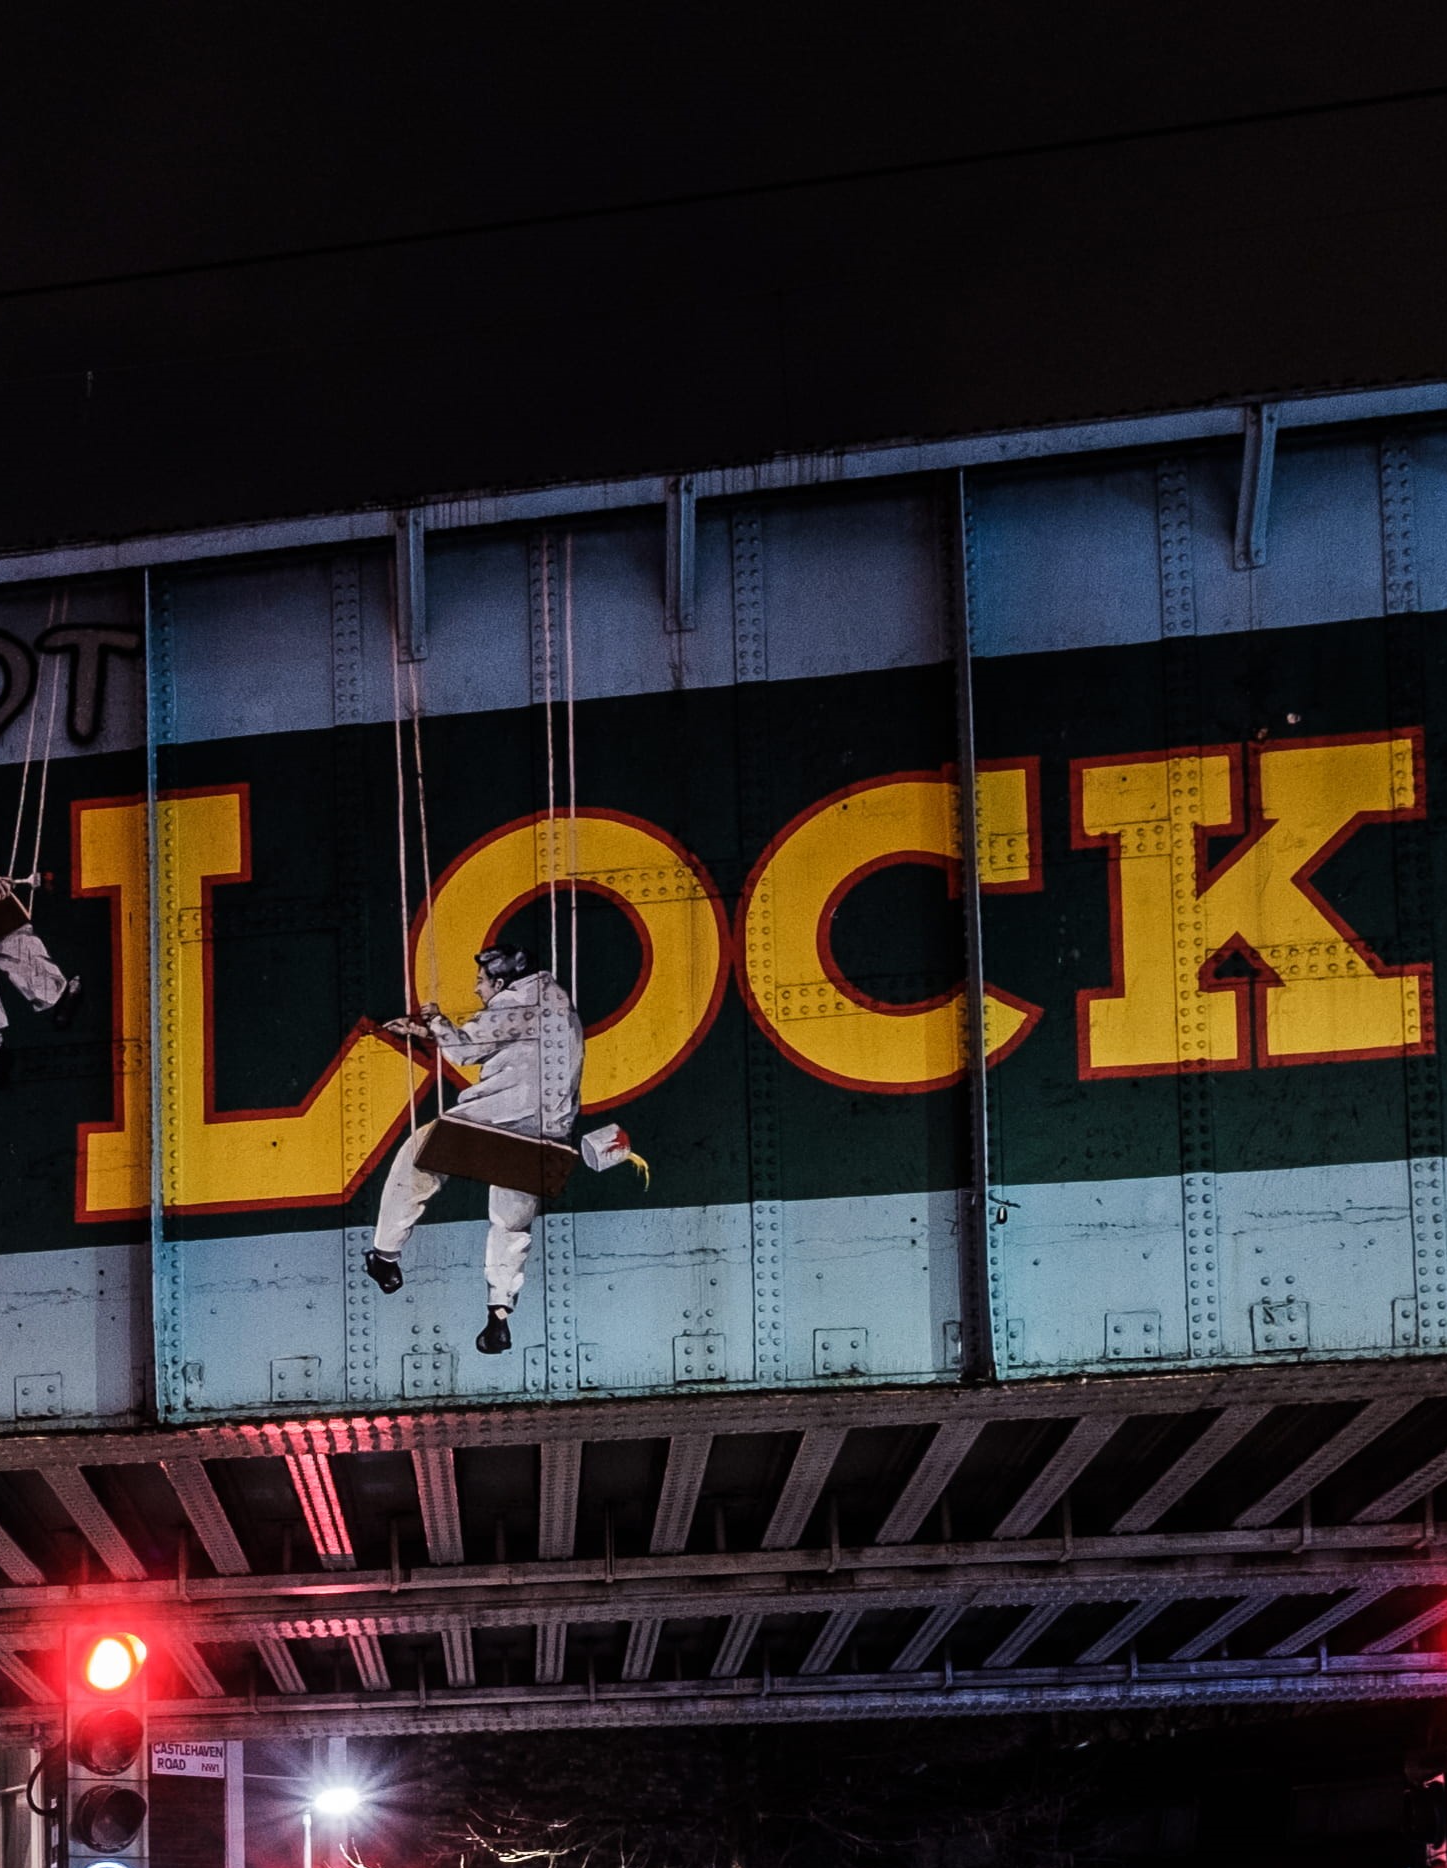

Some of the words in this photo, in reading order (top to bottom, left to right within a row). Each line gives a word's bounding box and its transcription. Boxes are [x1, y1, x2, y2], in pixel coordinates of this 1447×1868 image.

[71, 725, 1436, 1222] LOCK
[153, 1742, 223, 1758] CASTLEHAVEN
[157, 1758, 186, 1770] ROAD
[201, 1763, 219, 1772] NW1
